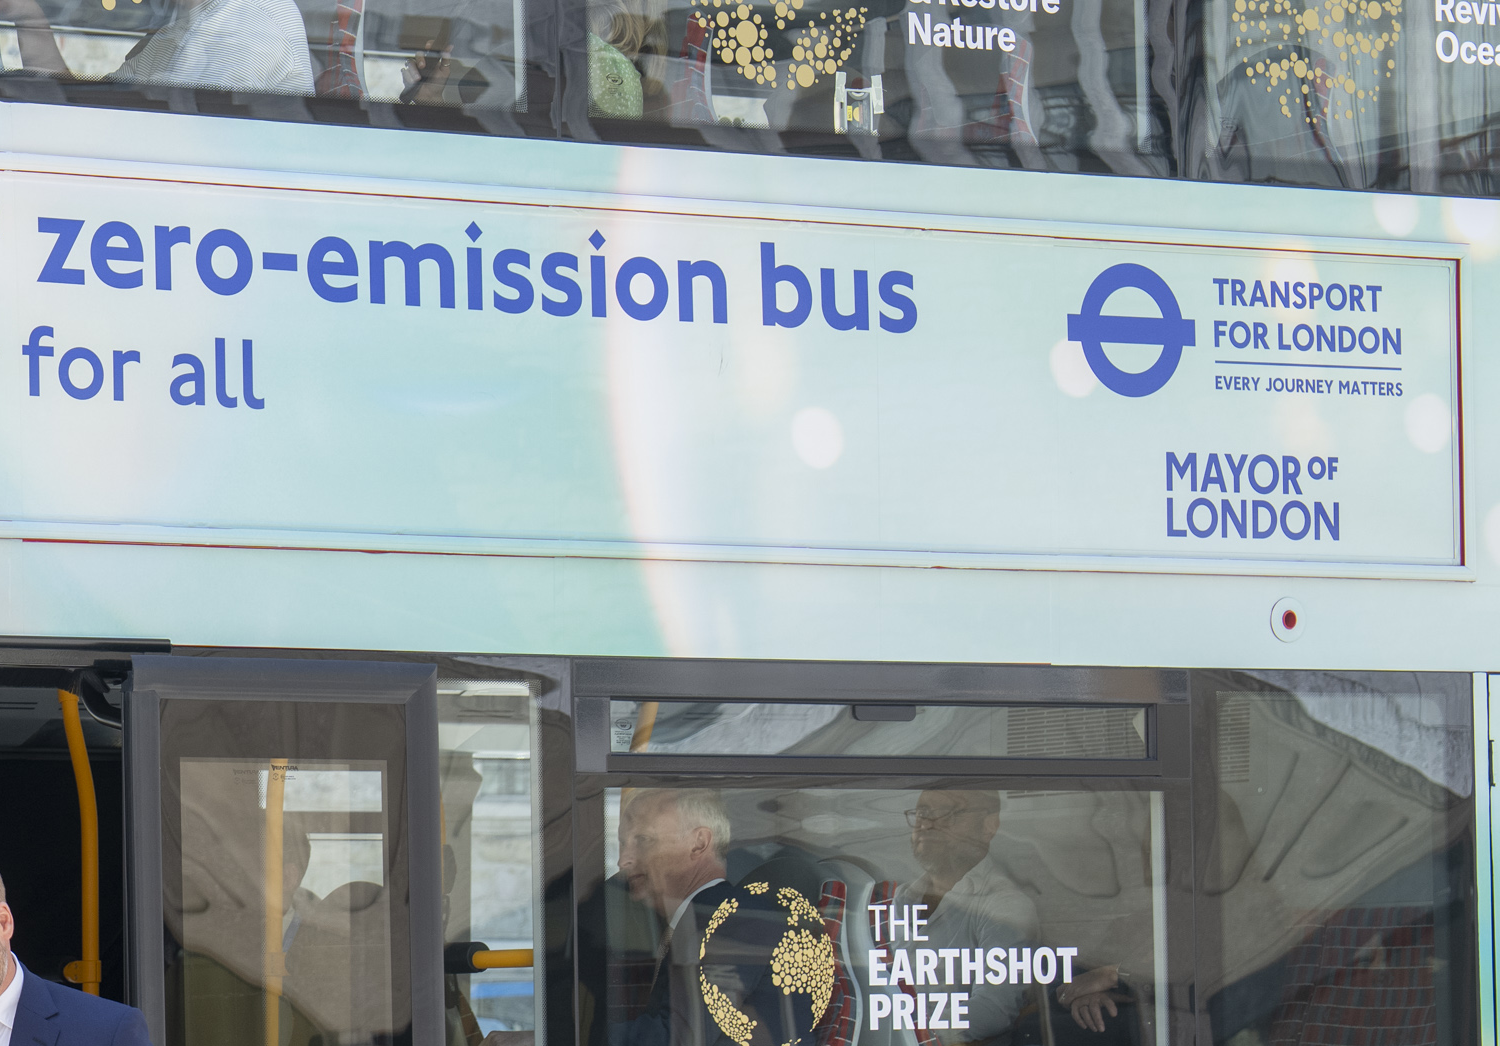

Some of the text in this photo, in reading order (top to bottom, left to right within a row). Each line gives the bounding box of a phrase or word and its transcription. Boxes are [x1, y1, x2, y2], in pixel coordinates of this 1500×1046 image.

[908, 11, 1017, 52] Nature
[1435, 0, 1500, 26] Revi
[37, 217, 728, 325] zero-emission
[761, 241, 918, 334] bus
[1212, 277, 1383, 313] TRANSPORT
[1213, 320, 1402, 355] FOR LONDON
[22, 325, 141, 402] for
[170, 337, 266, 410] all
[1214, 375, 1404, 398] EVERY JOURNEY MATTERS
[1165, 451, 1339, 496] MAYOR OF
[1166, 497, 1340, 541] LONDON
[867, 904, 930, 942] THE
[868, 946, 1078, 986] EARTHSHOT
[869, 992, 971, 1031] PRIZE
